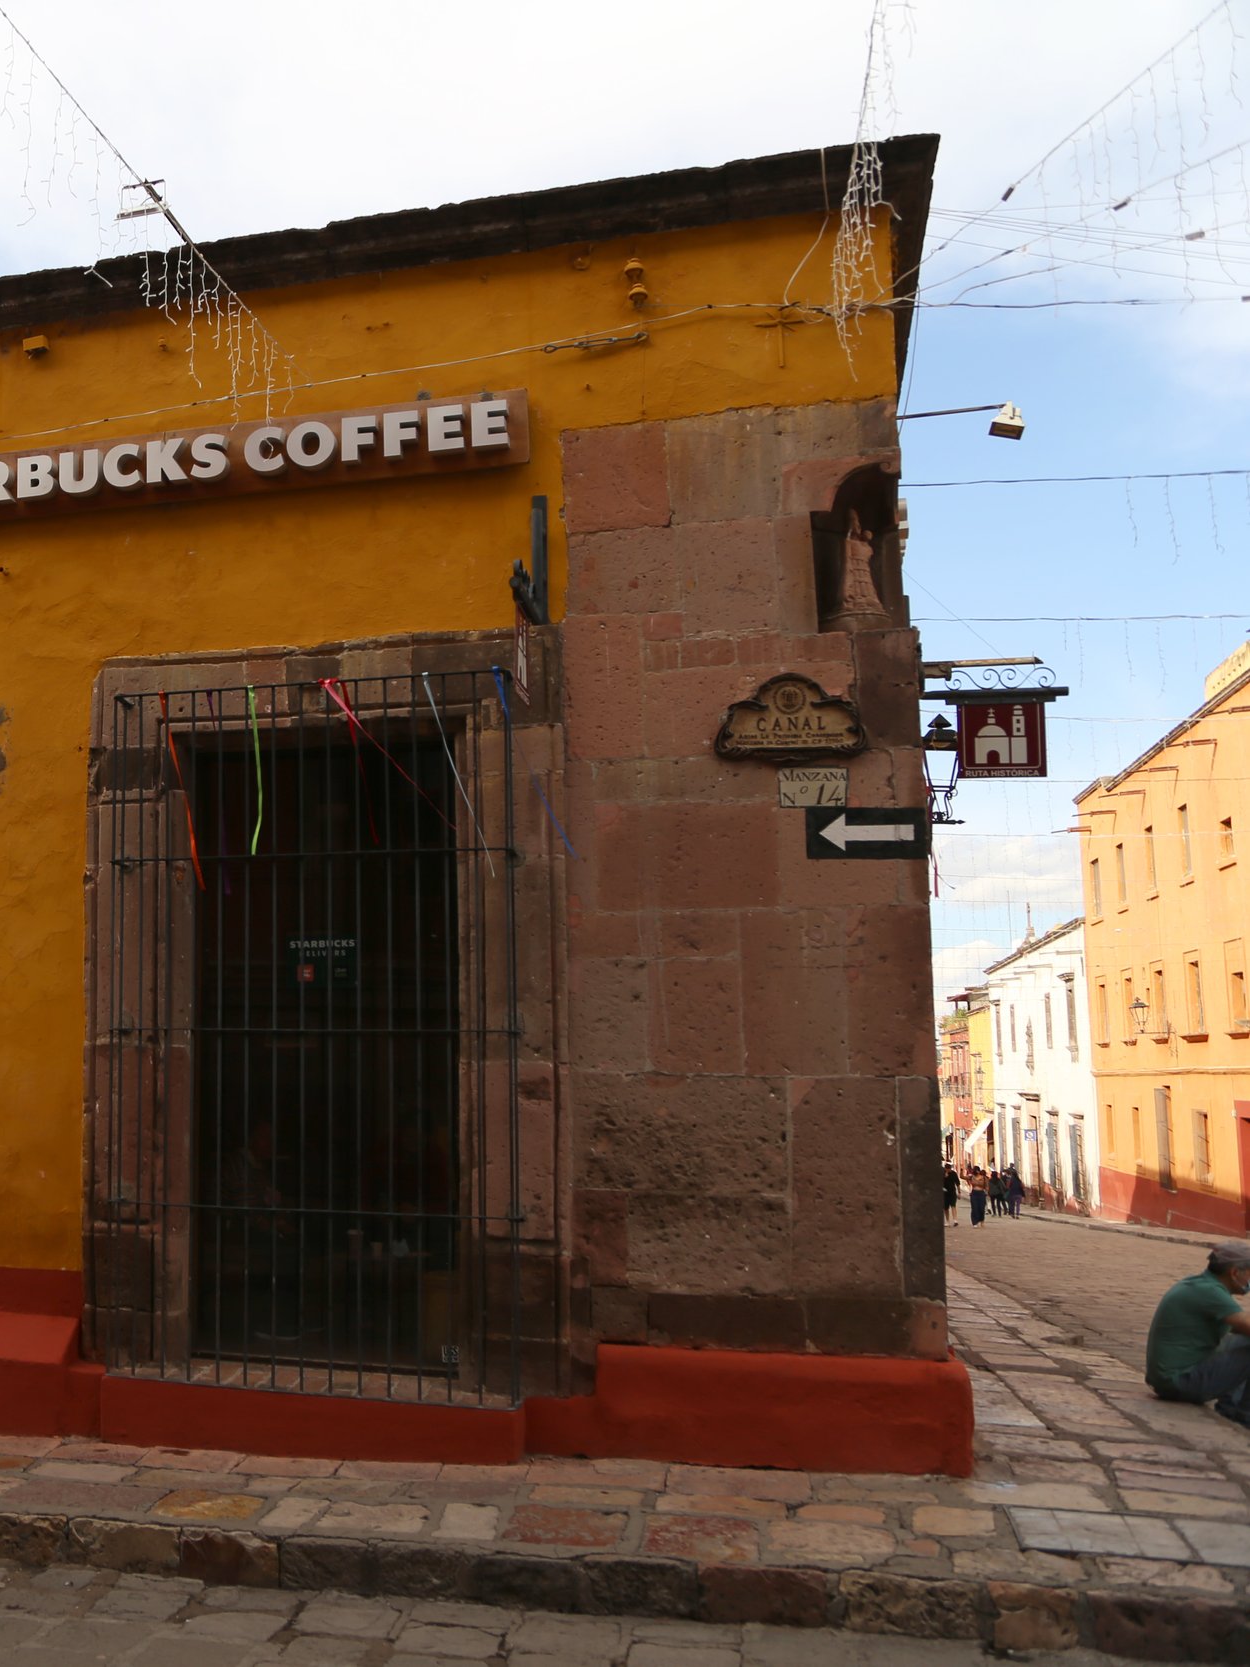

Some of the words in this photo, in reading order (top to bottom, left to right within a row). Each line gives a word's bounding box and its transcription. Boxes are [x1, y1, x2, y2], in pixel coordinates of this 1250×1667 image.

[244, 399, 511, 474] COFFEE
[756, 716, 826, 732] CANAL
[782, 769, 847, 782] MANZANA
[965, 769, 990, 777] RUTA
[991, 768, 1040, 777] HISTÓRICA
